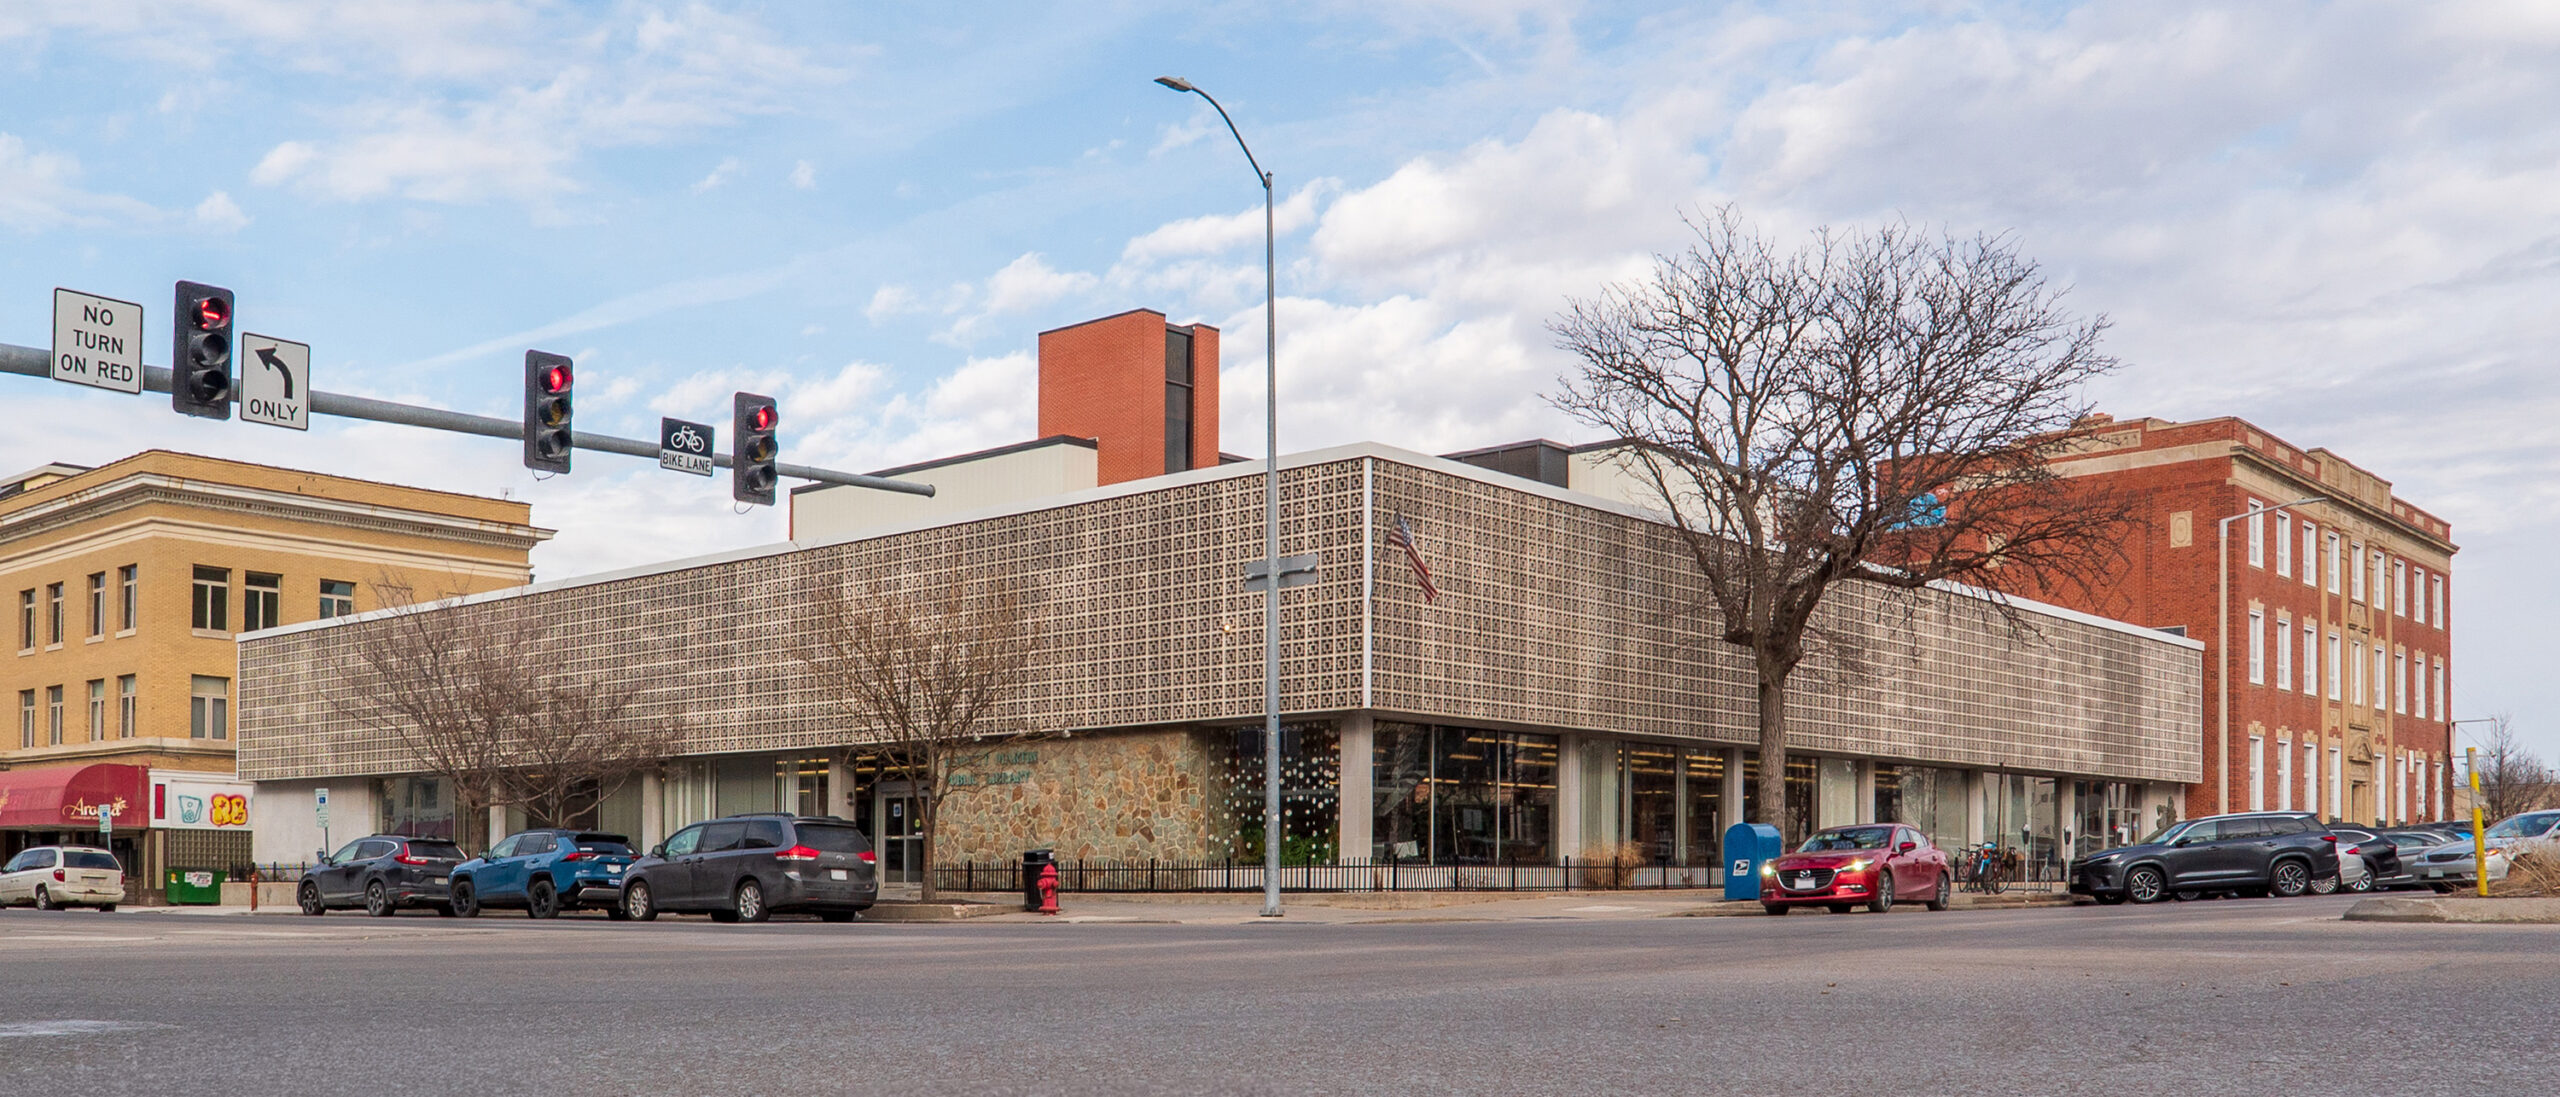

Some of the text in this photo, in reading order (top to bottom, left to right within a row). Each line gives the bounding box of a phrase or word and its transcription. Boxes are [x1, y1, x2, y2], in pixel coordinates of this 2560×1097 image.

[84, 305, 113, 326] NO
[73, 329, 123, 354] TURN
[61, 354, 133, 382] ON RED
[250, 399, 298, 421] ONLY
[663, 453, 710, 472] BIKE LANE
[62, 797, 121, 816] Aroa
